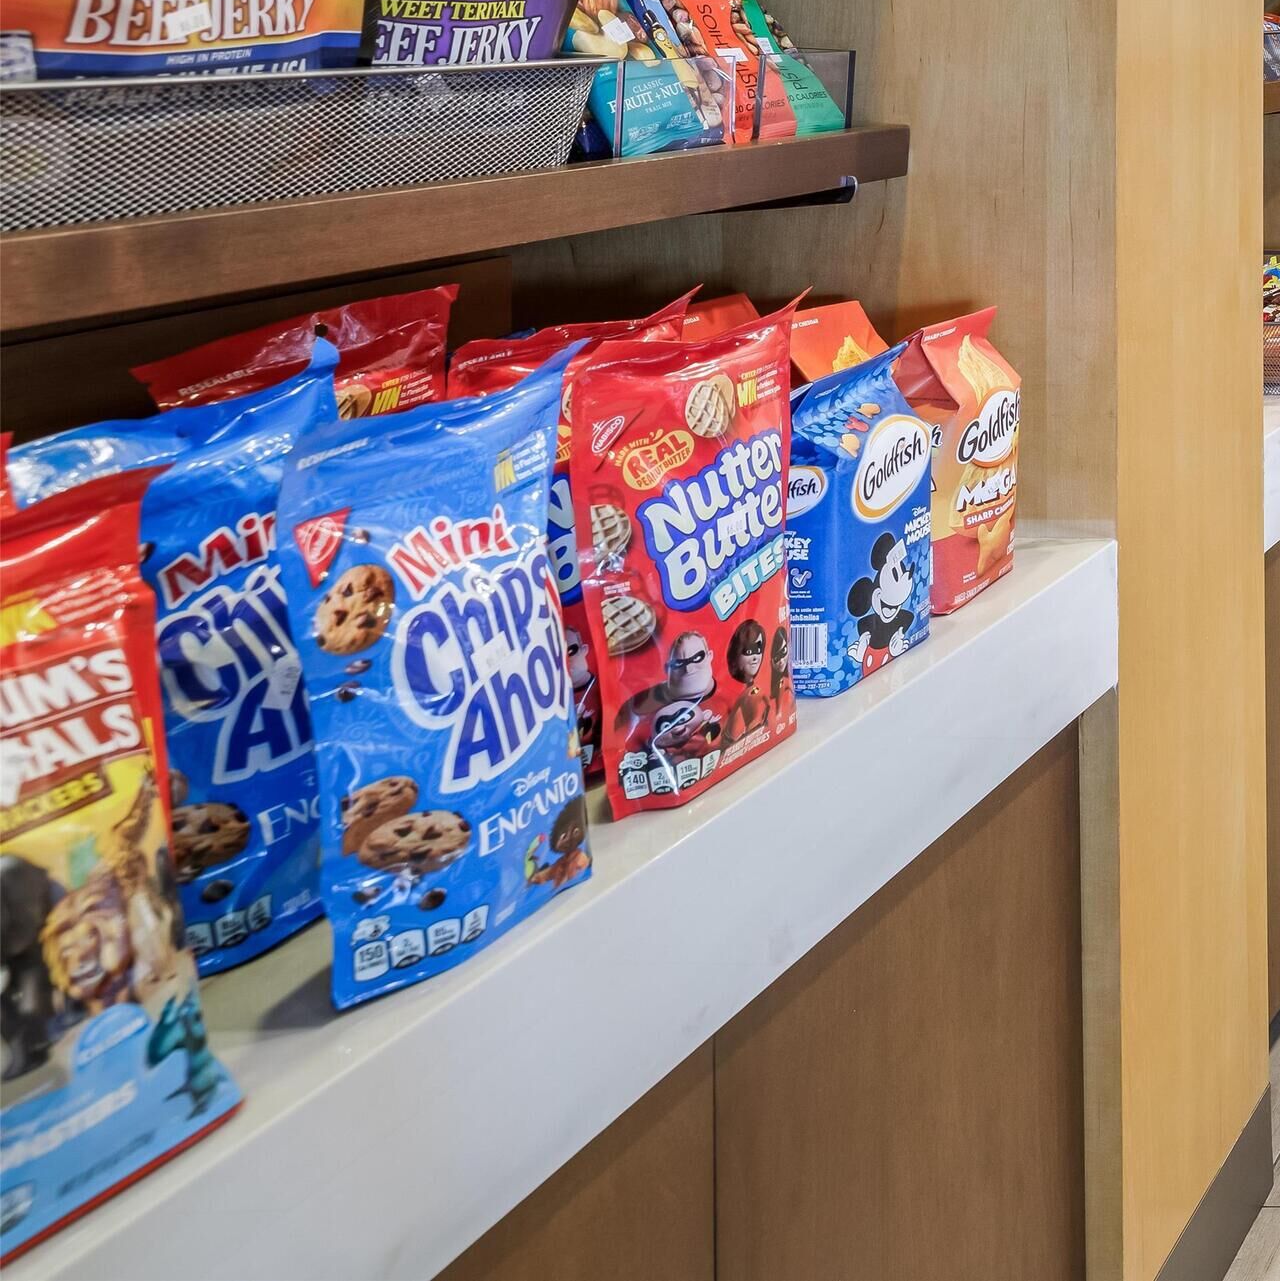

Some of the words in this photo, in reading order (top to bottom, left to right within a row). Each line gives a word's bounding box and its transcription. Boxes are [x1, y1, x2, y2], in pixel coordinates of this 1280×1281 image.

[450, 0, 526, 20] TERIYAKI
[166, 55, 194, 66] HIGH
[197, 53, 209, 63] IN
[210, 48, 252, 62] PROTEIN
[372, 21, 442, 65] EEF
[438, 17, 541, 65] JERKY
[633, 78, 663, 94] CLASSIC
[178, 368, 255, 397] RESEALABLE
[595, 418, 622, 451] NABISCO
[628, 436, 650, 450] WITH
[627, 432, 688, 480] REAL
[636, 465, 662, 488] PEANUT
[662, 447, 691, 470] BUTTER
[863, 430, 924, 501] Goldfish
[645, 433, 782, 553] Nutter
[966, 510, 993, 526] SHARP
[388, 505, 514, 597] Mini
[479, 771, 579, 857] ENCANTO
